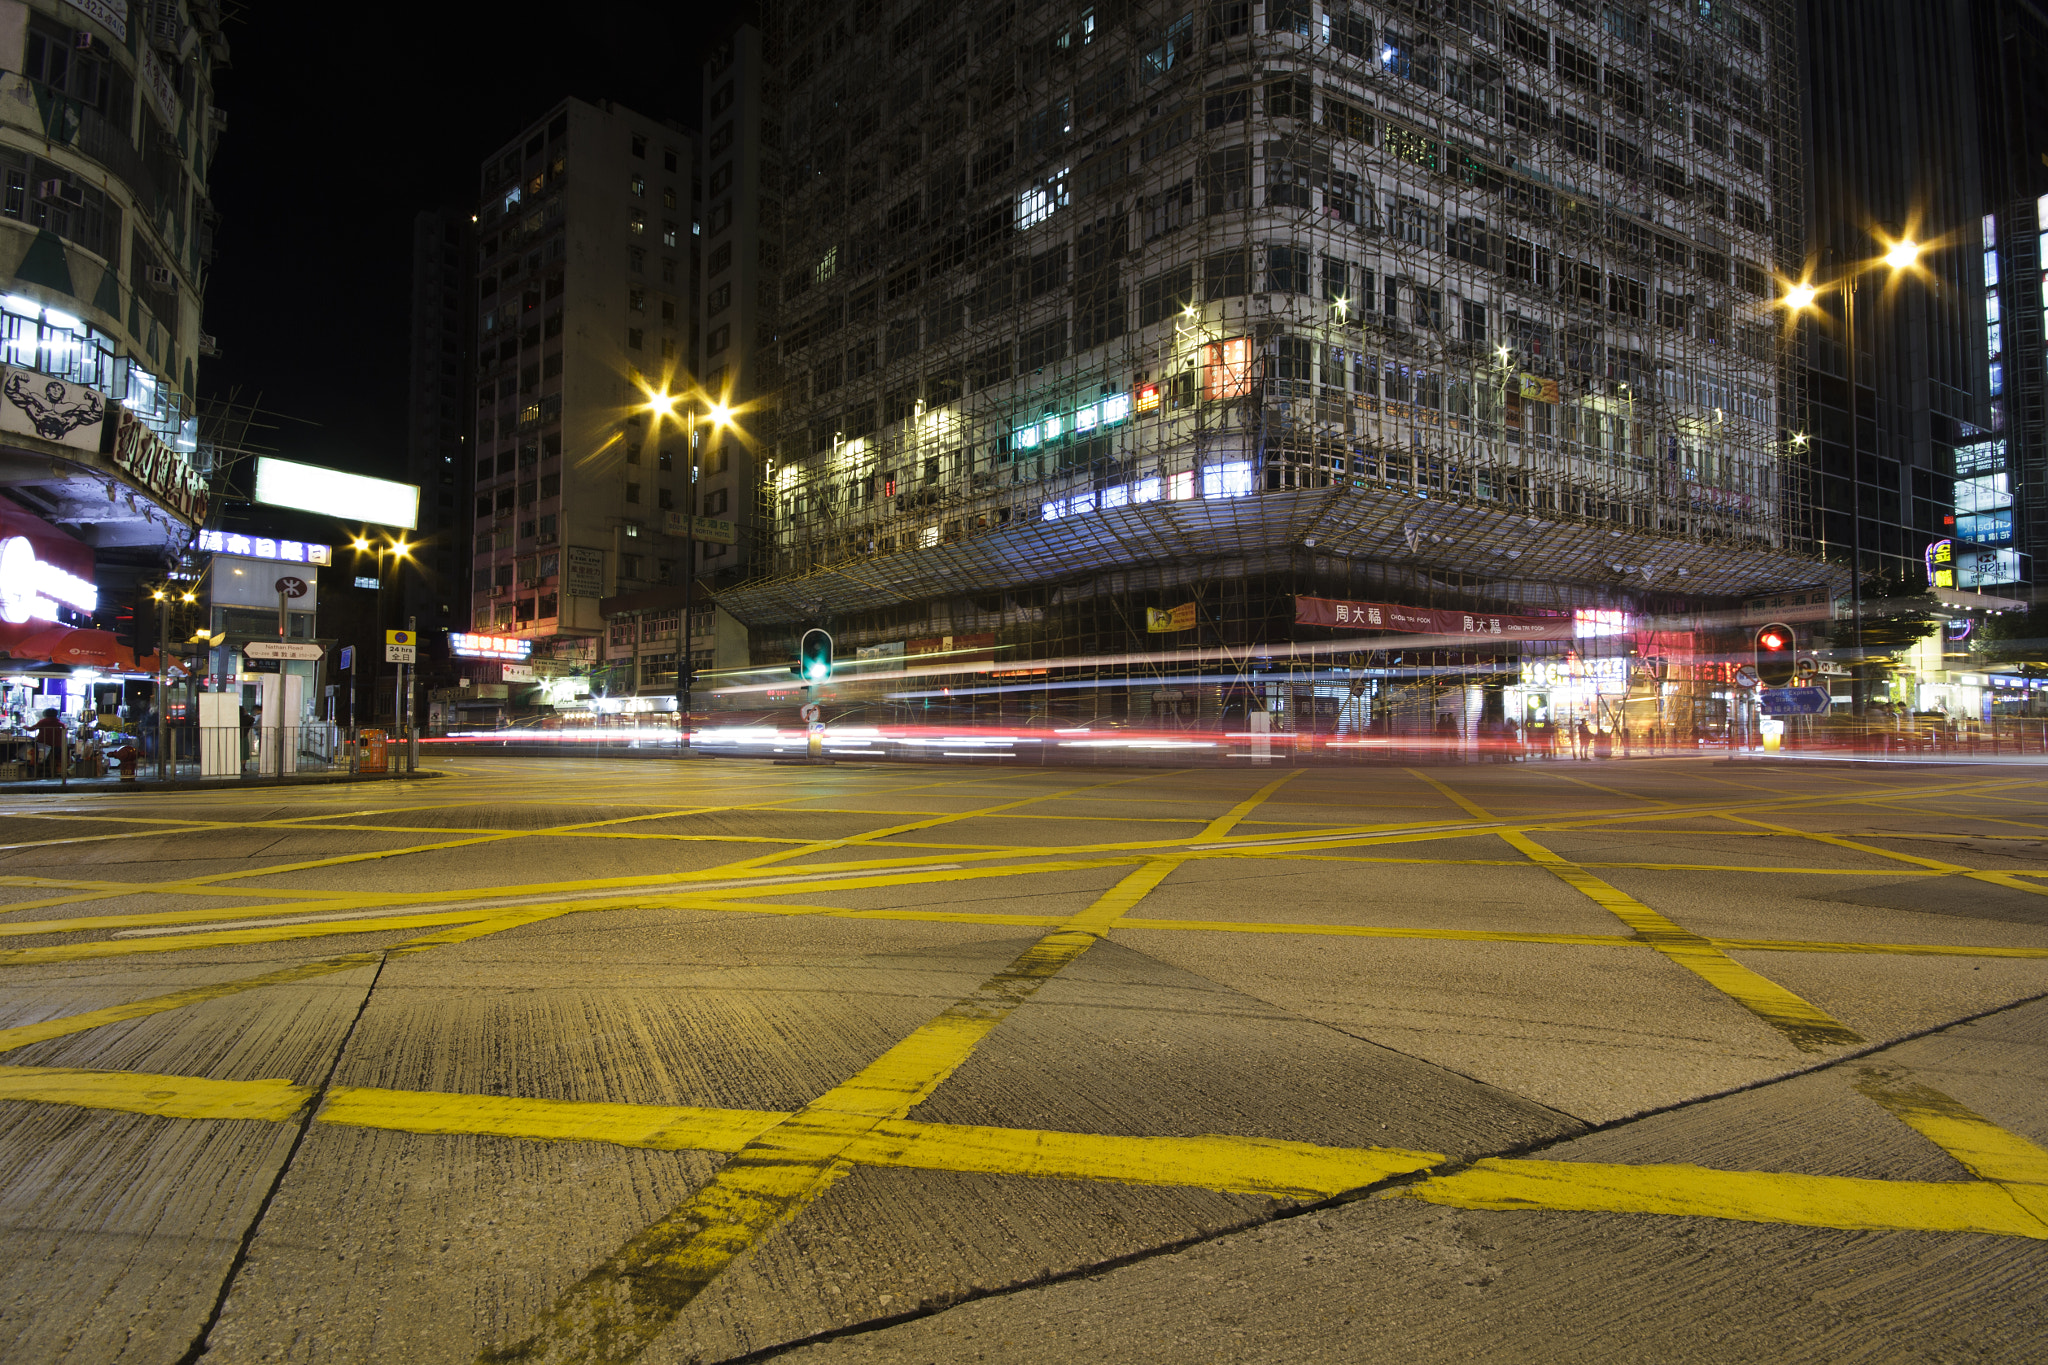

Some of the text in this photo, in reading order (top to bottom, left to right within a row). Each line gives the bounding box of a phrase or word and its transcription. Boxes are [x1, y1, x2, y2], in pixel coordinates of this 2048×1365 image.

[1336, 604, 1382, 625] 周大福
[1463, 615, 1501, 634] 周大福
[391, 653, 410, 662] 全日
[1788, 689, 1813, 697] Express
